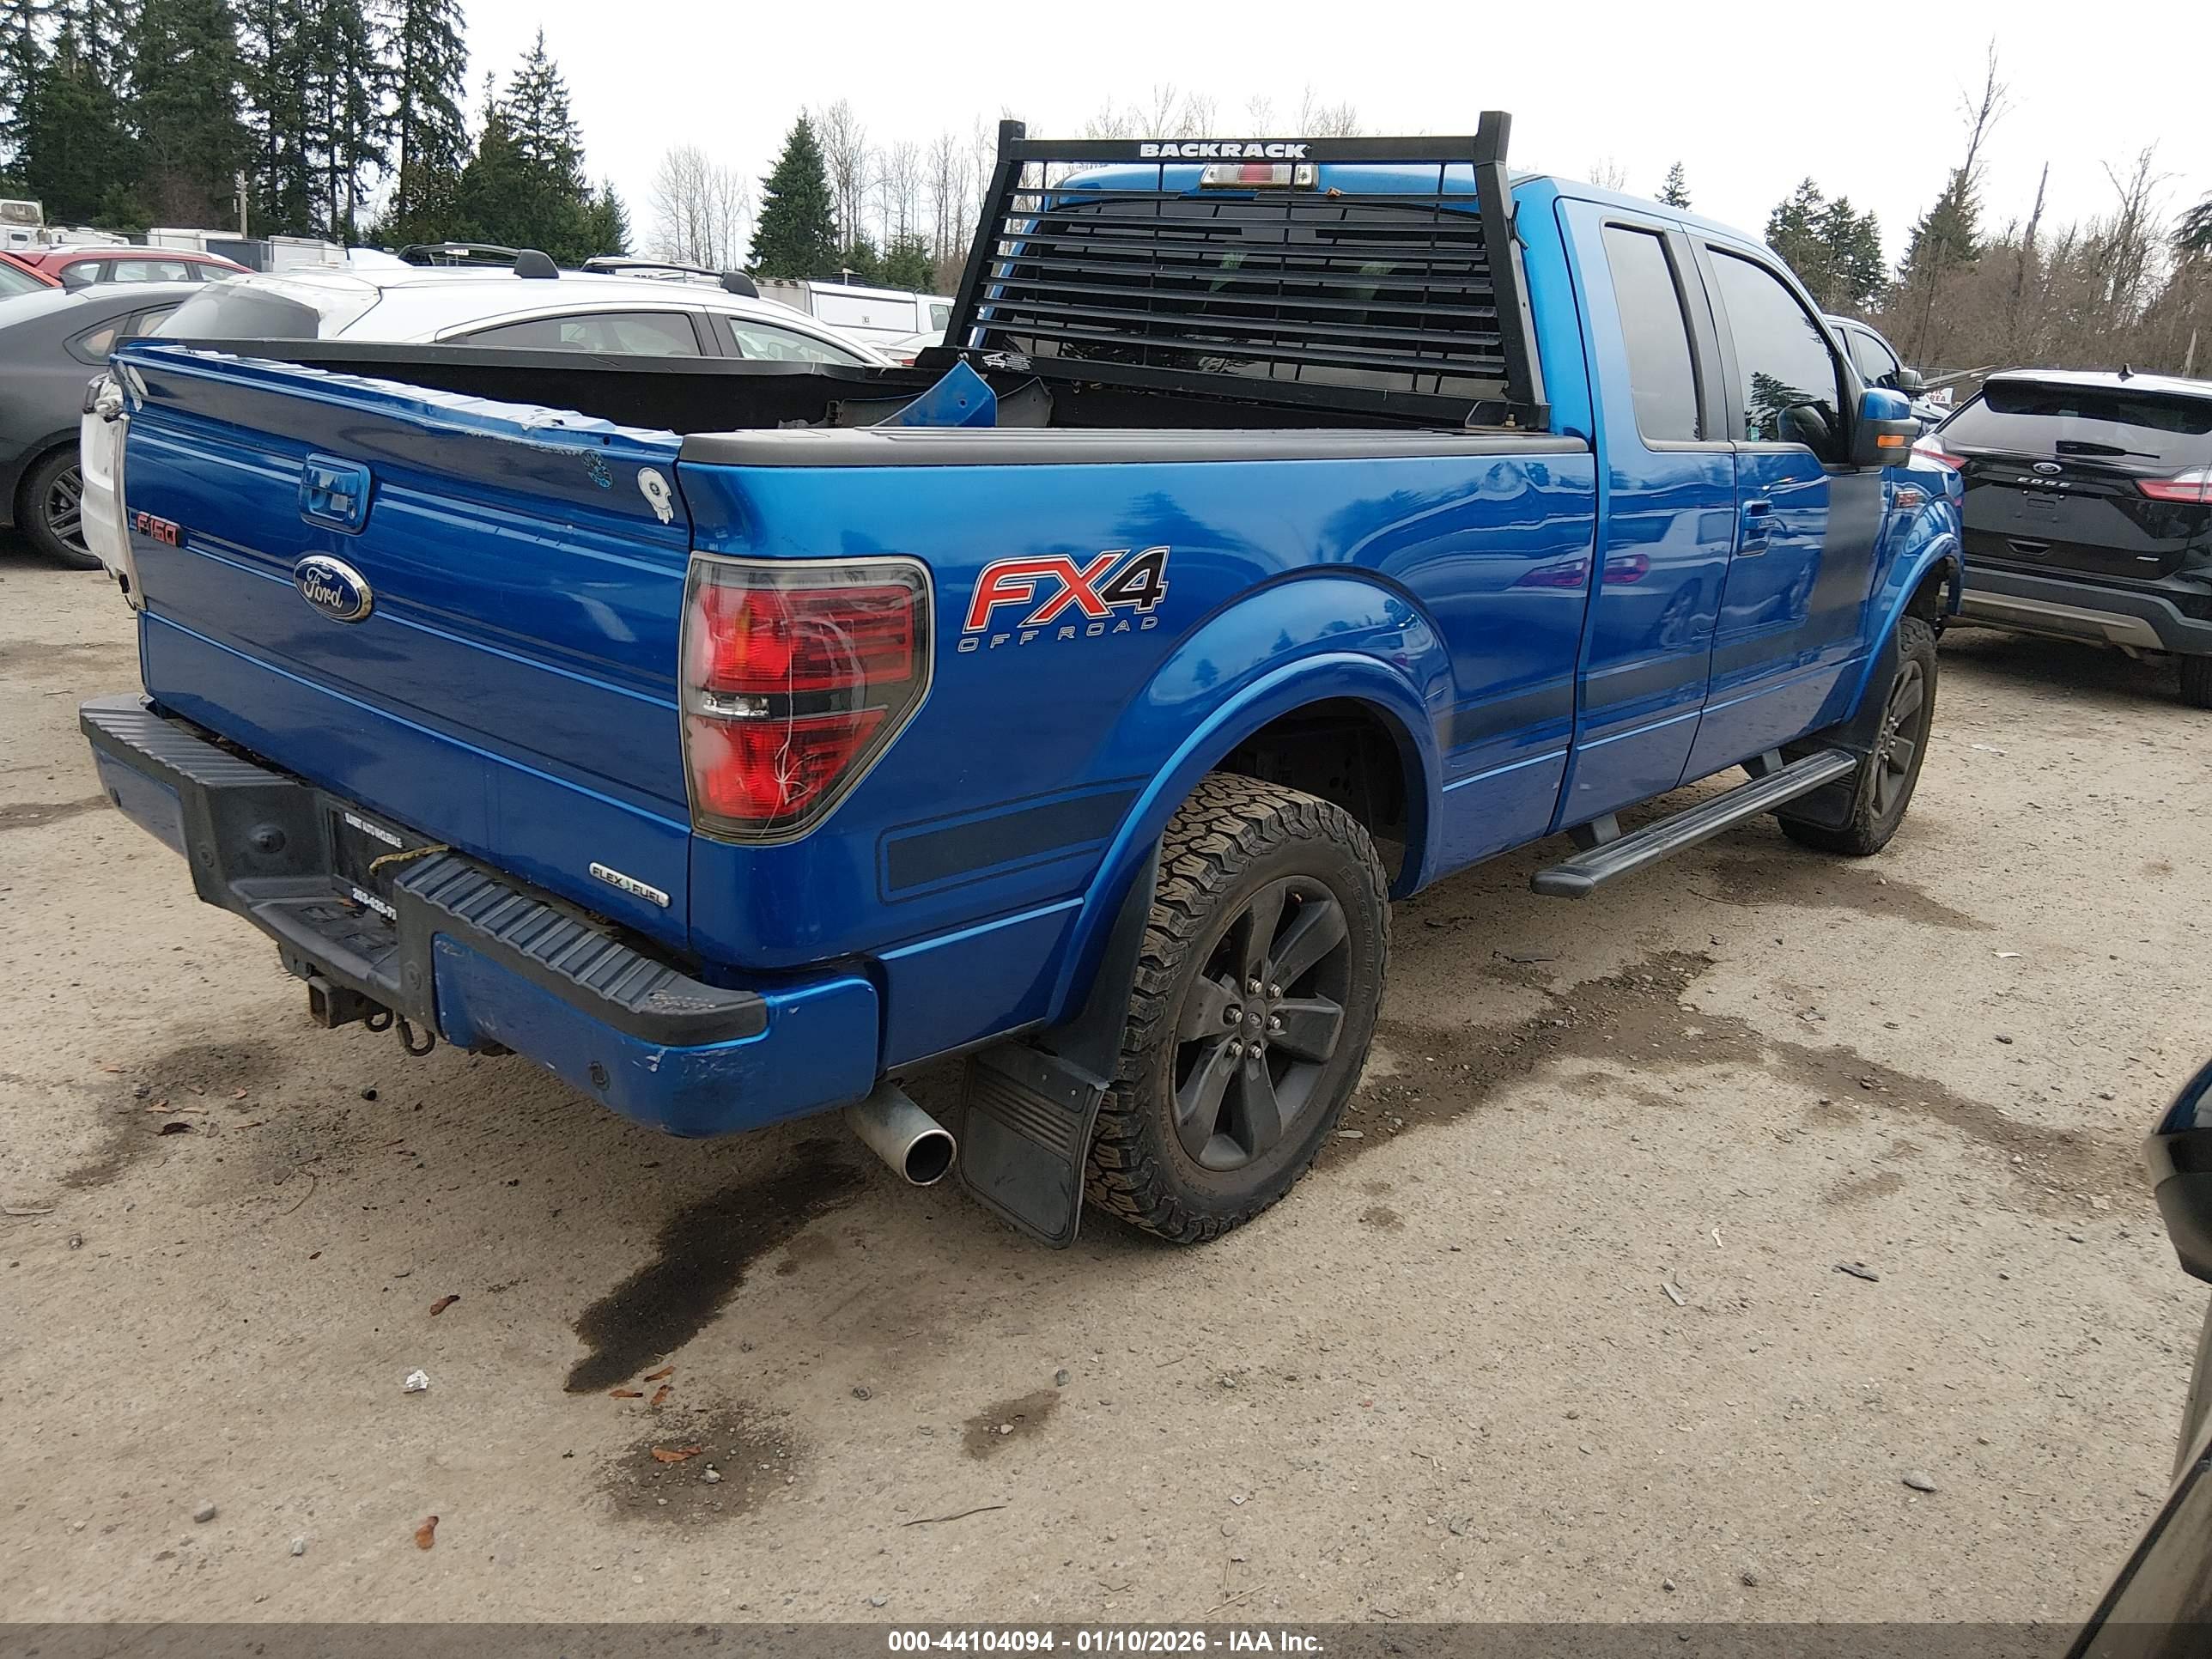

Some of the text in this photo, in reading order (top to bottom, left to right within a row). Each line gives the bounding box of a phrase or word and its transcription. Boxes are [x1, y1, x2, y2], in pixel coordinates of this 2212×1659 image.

[1139, 143, 1308, 159] BACKRACK
[2017, 477, 2071, 488] EDGE
[303, 567, 343, 609] Ford
[962, 544, 1170, 635] FX4
[957, 616, 1158, 653] OFF ROAD
[592, 866, 664, 907] FLEX FUEL
